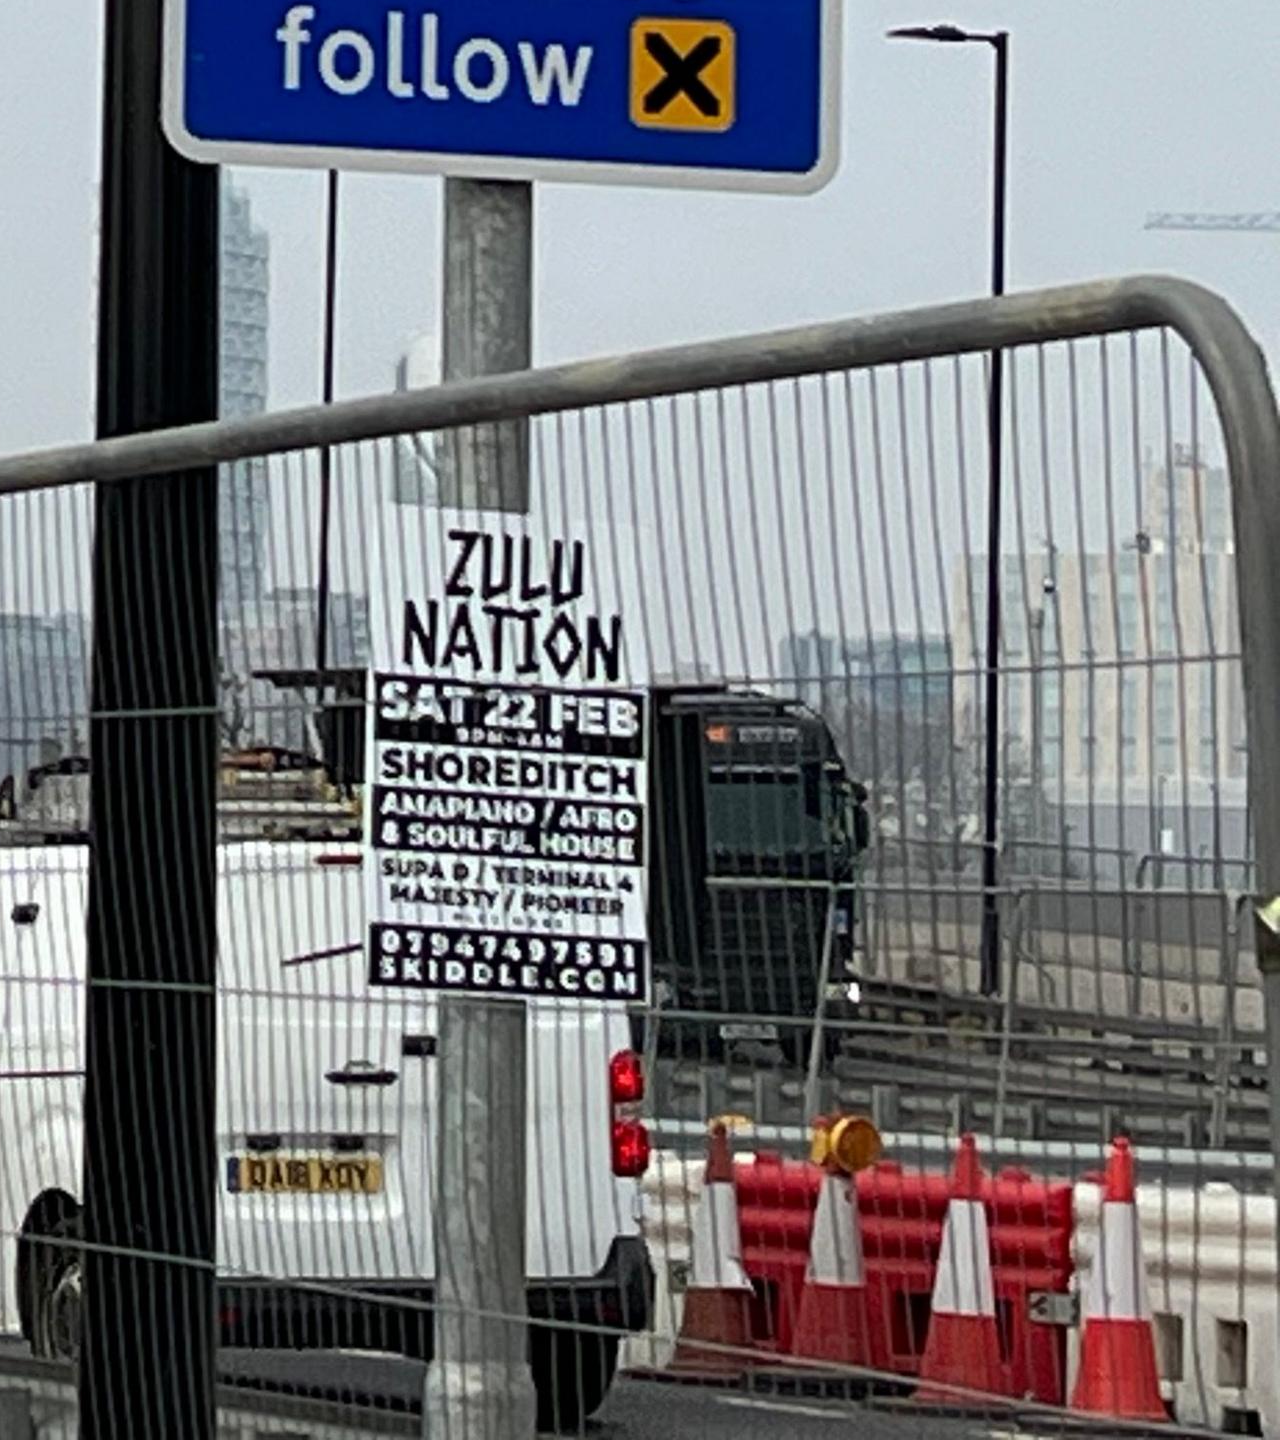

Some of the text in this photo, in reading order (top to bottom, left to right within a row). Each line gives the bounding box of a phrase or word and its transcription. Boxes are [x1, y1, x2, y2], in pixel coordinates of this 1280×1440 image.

[276, 4, 594, 107] follow
[446, 528, 585, 607] ZULU
[403, 599, 622, 683] NATION
[380, 680, 640, 738] SAT 22 FEB
[381, 747, 637, 796] SHOREDITCH
[379, 790, 536, 825] AMAPIANO
[559, 804, 638, 833] AFRO
[381, 819, 636, 861] & SOULFUL HOUSE
[390, 882, 500, 909] MAJESTY
[522, 890, 625, 915] PIONEER
[492, 864, 611, 892] TERMINAL
[378, 955, 638, 996] SKIDDLE.COM
